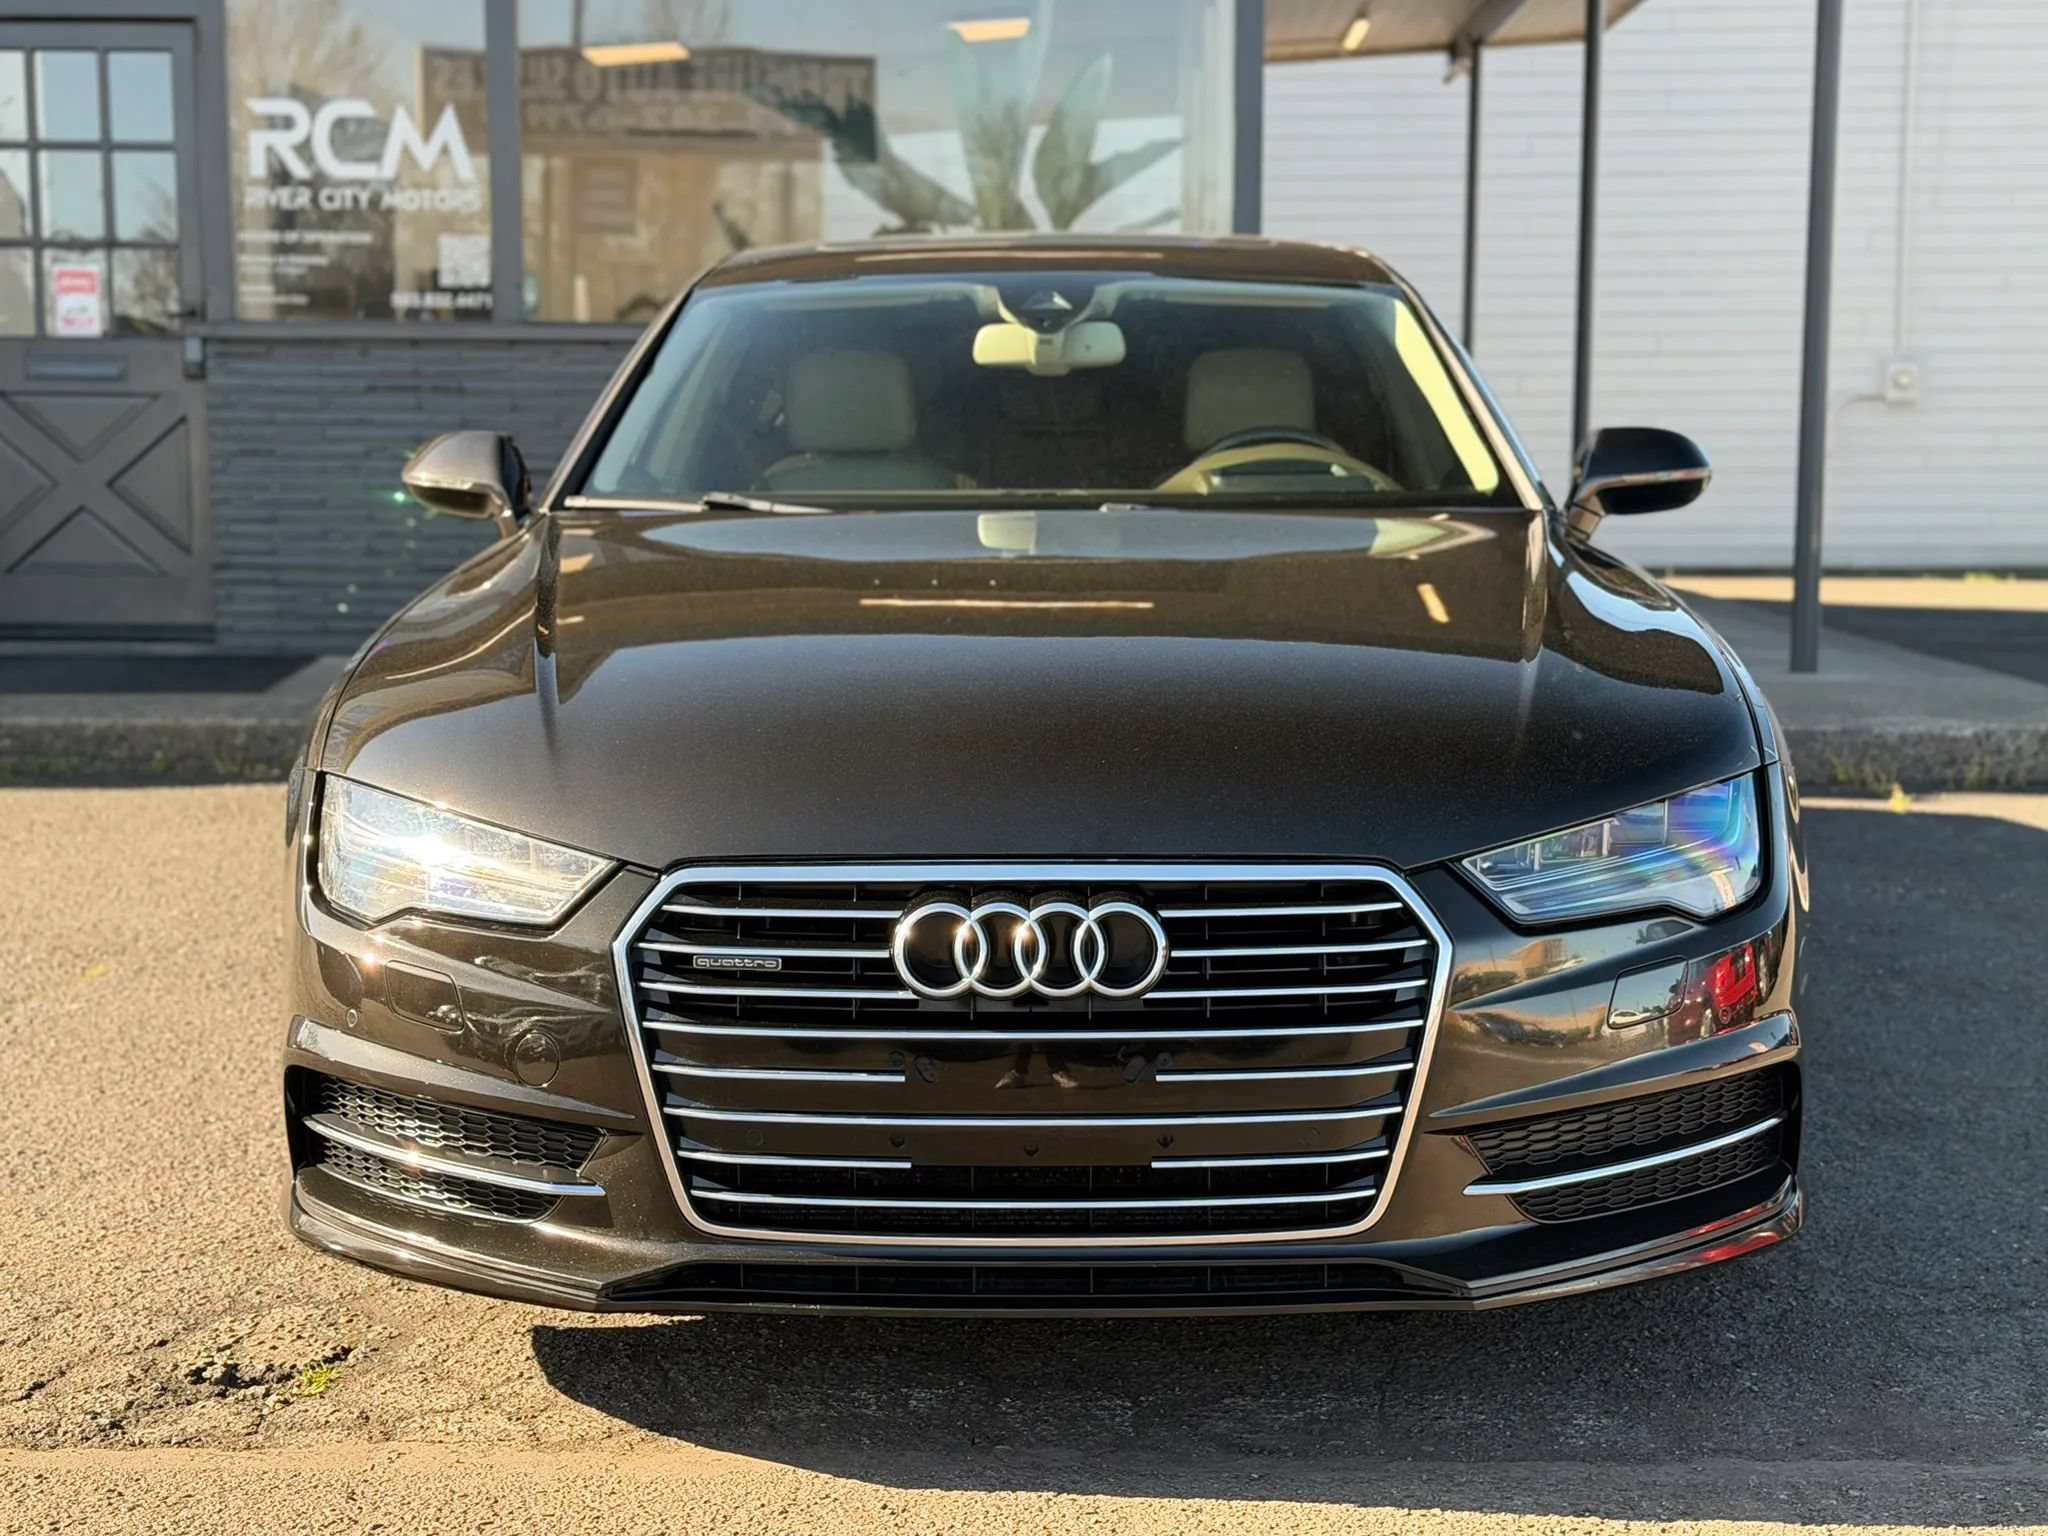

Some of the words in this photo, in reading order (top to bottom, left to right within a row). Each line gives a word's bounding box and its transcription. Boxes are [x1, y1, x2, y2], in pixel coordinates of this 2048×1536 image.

[246, 98, 477, 181] RCM
[318, 187, 372, 211] CITY
[696, 957, 778, 968] quattro
